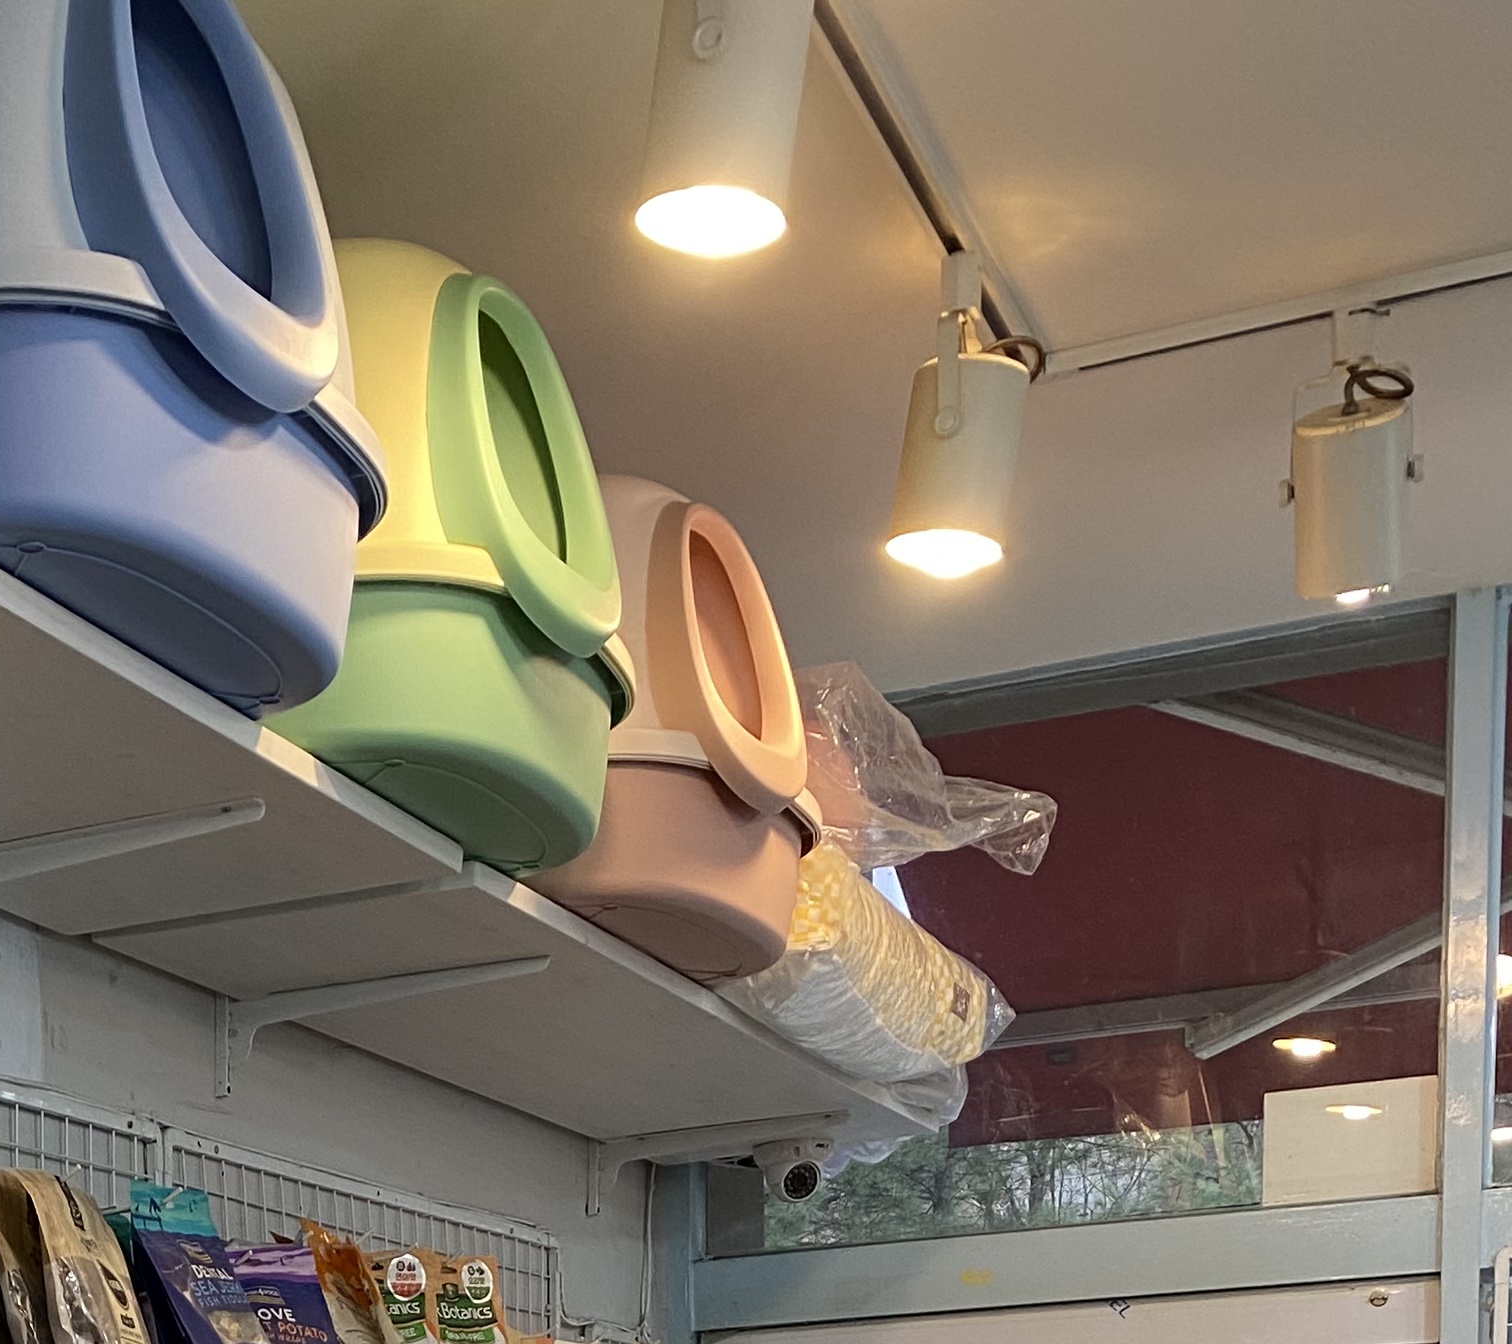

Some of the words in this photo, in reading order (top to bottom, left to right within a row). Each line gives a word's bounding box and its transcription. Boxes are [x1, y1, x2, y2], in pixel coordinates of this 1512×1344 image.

[191, 1281, 217, 1298] SEA
[257, 1307, 297, 1323] OVE
[386, 1301, 421, 1316] anics
[442, 1303, 494, 1321] Botanics
[278, 1320, 328, 1343] POTATO
